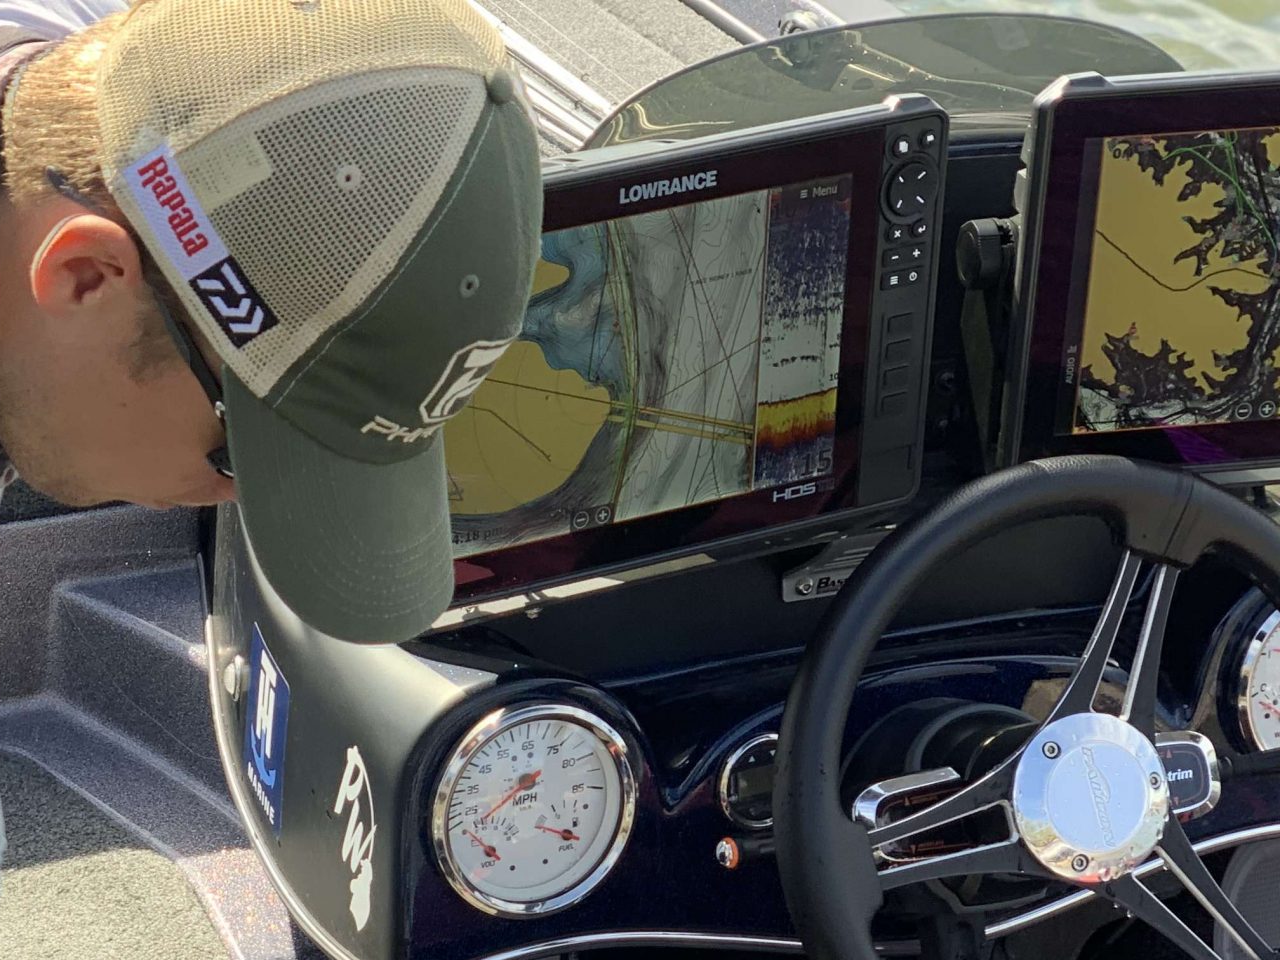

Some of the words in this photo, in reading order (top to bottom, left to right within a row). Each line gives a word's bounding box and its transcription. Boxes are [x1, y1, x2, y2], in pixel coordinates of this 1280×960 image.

[619, 170, 718, 205] LOWRANCE
[812, 184, 839, 199] Menu
[1065, 357, 1076, 385] AUDIO
[521, 740, 535, 751] 65
[546, 744, 561, 756] 75
[496, 750, 510, 760] 55
[561, 758, 576, 769] 80
[478, 764, 492, 775] 45
[1167, 768, 1193, 782] trim
[247, 761, 275, 825] MARINE
[466, 784, 480, 795] 35
[571, 783, 585, 793] 85
[512, 792, 538, 807] MPH
[464, 805, 478, 817] 25
[558, 843, 575, 852] FUEL
[480, 860, 497, 869] VOLT
